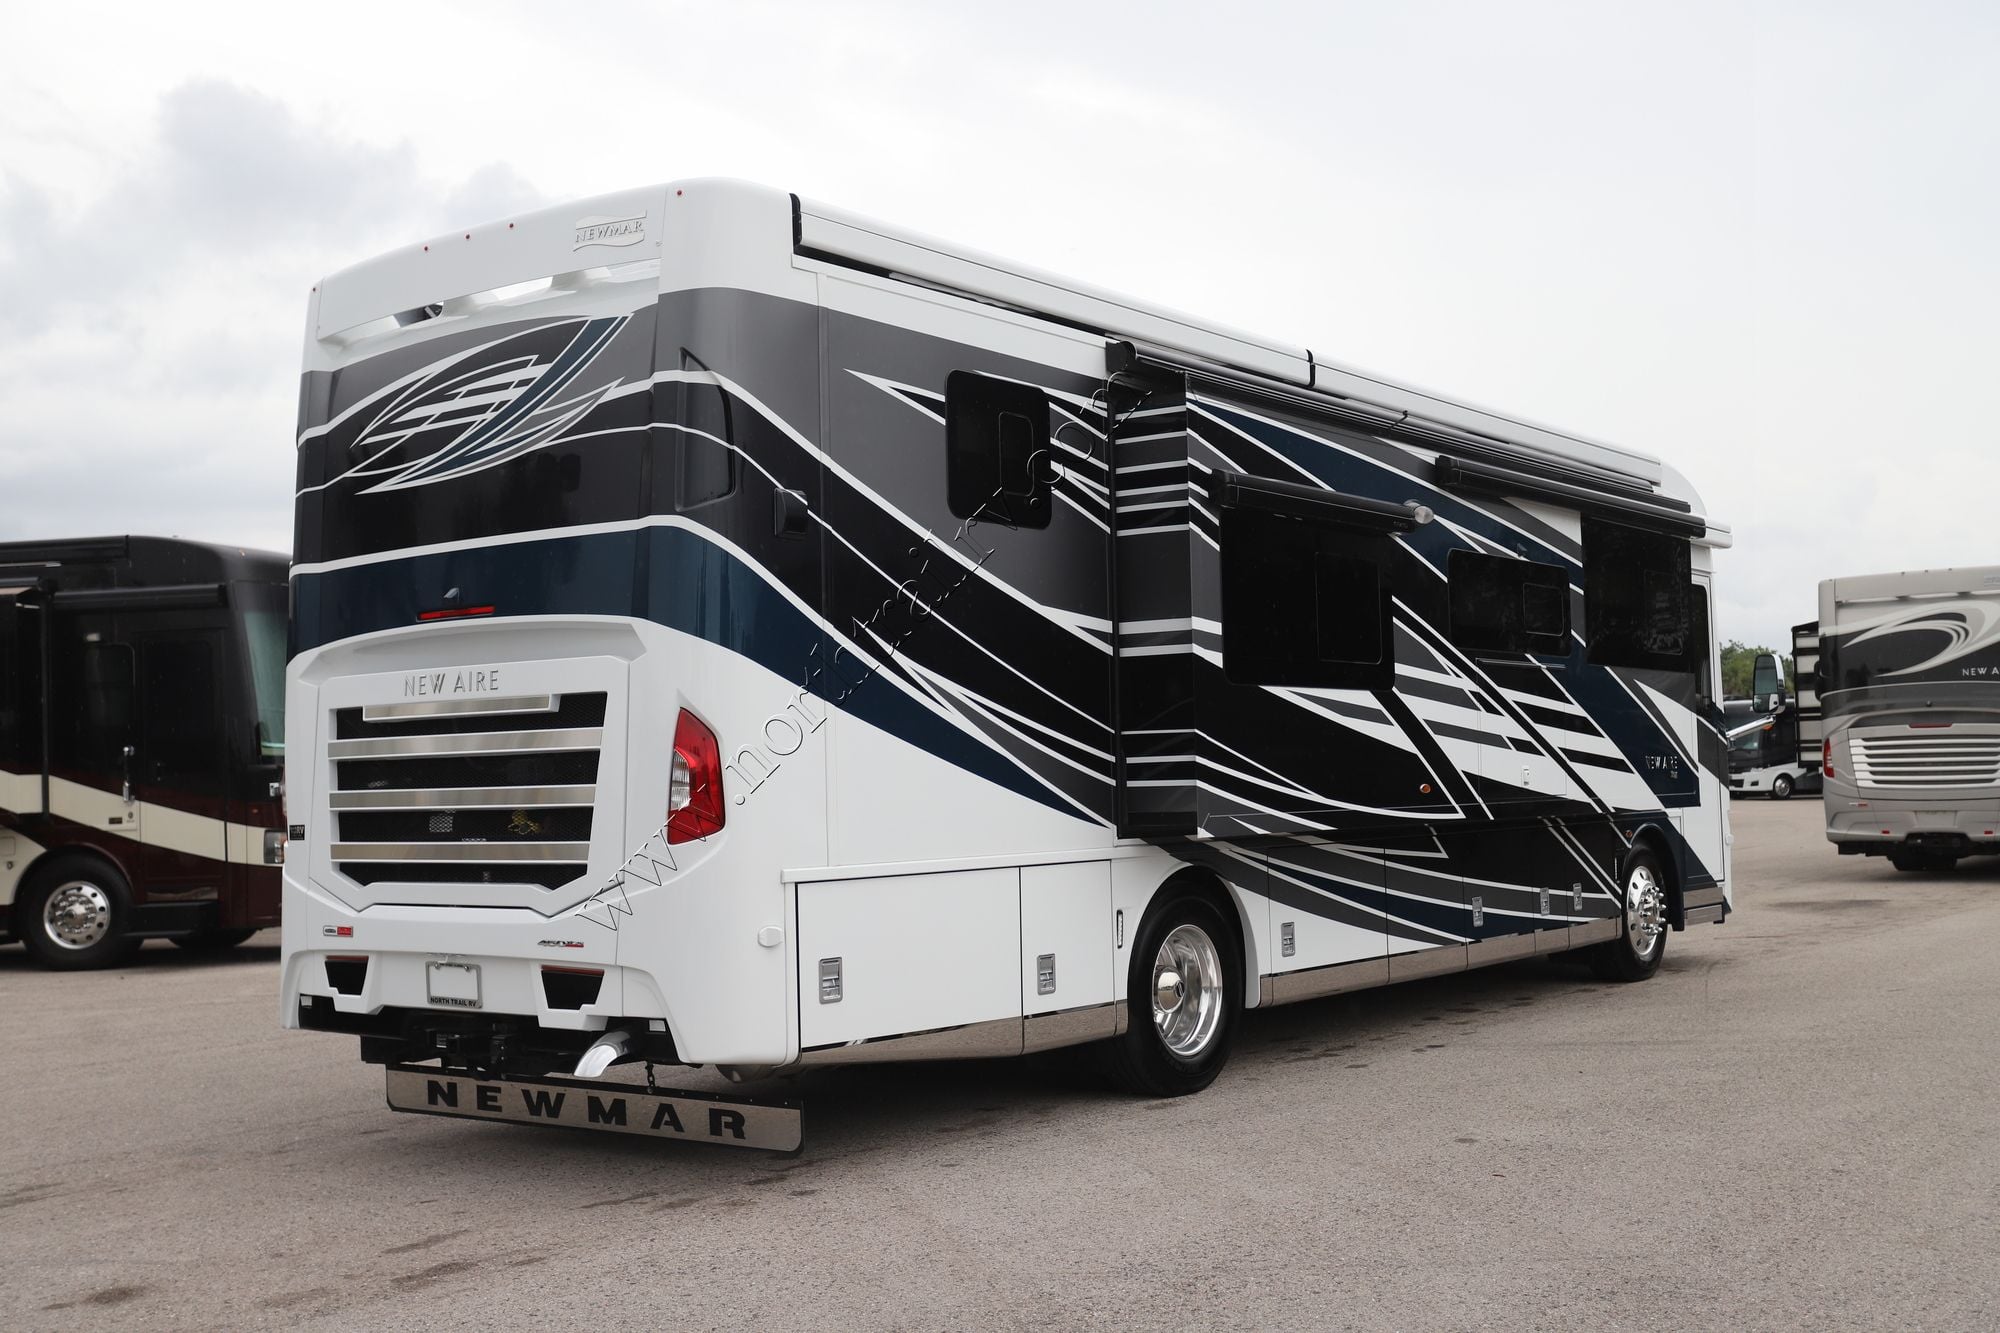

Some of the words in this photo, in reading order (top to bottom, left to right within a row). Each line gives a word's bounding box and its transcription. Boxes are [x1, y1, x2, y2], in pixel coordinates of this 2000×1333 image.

[575, 220, 645, 243] NEWMAR
[1962, 666, 1988, 677] NEW
[404, 672, 446, 697] NEW
[453, 669, 499, 693] AIRE
[1662, 755, 1678, 769] ARE
[430, 997, 450, 1005] NORTH
[427, 1080, 746, 1140] NEWMAR
